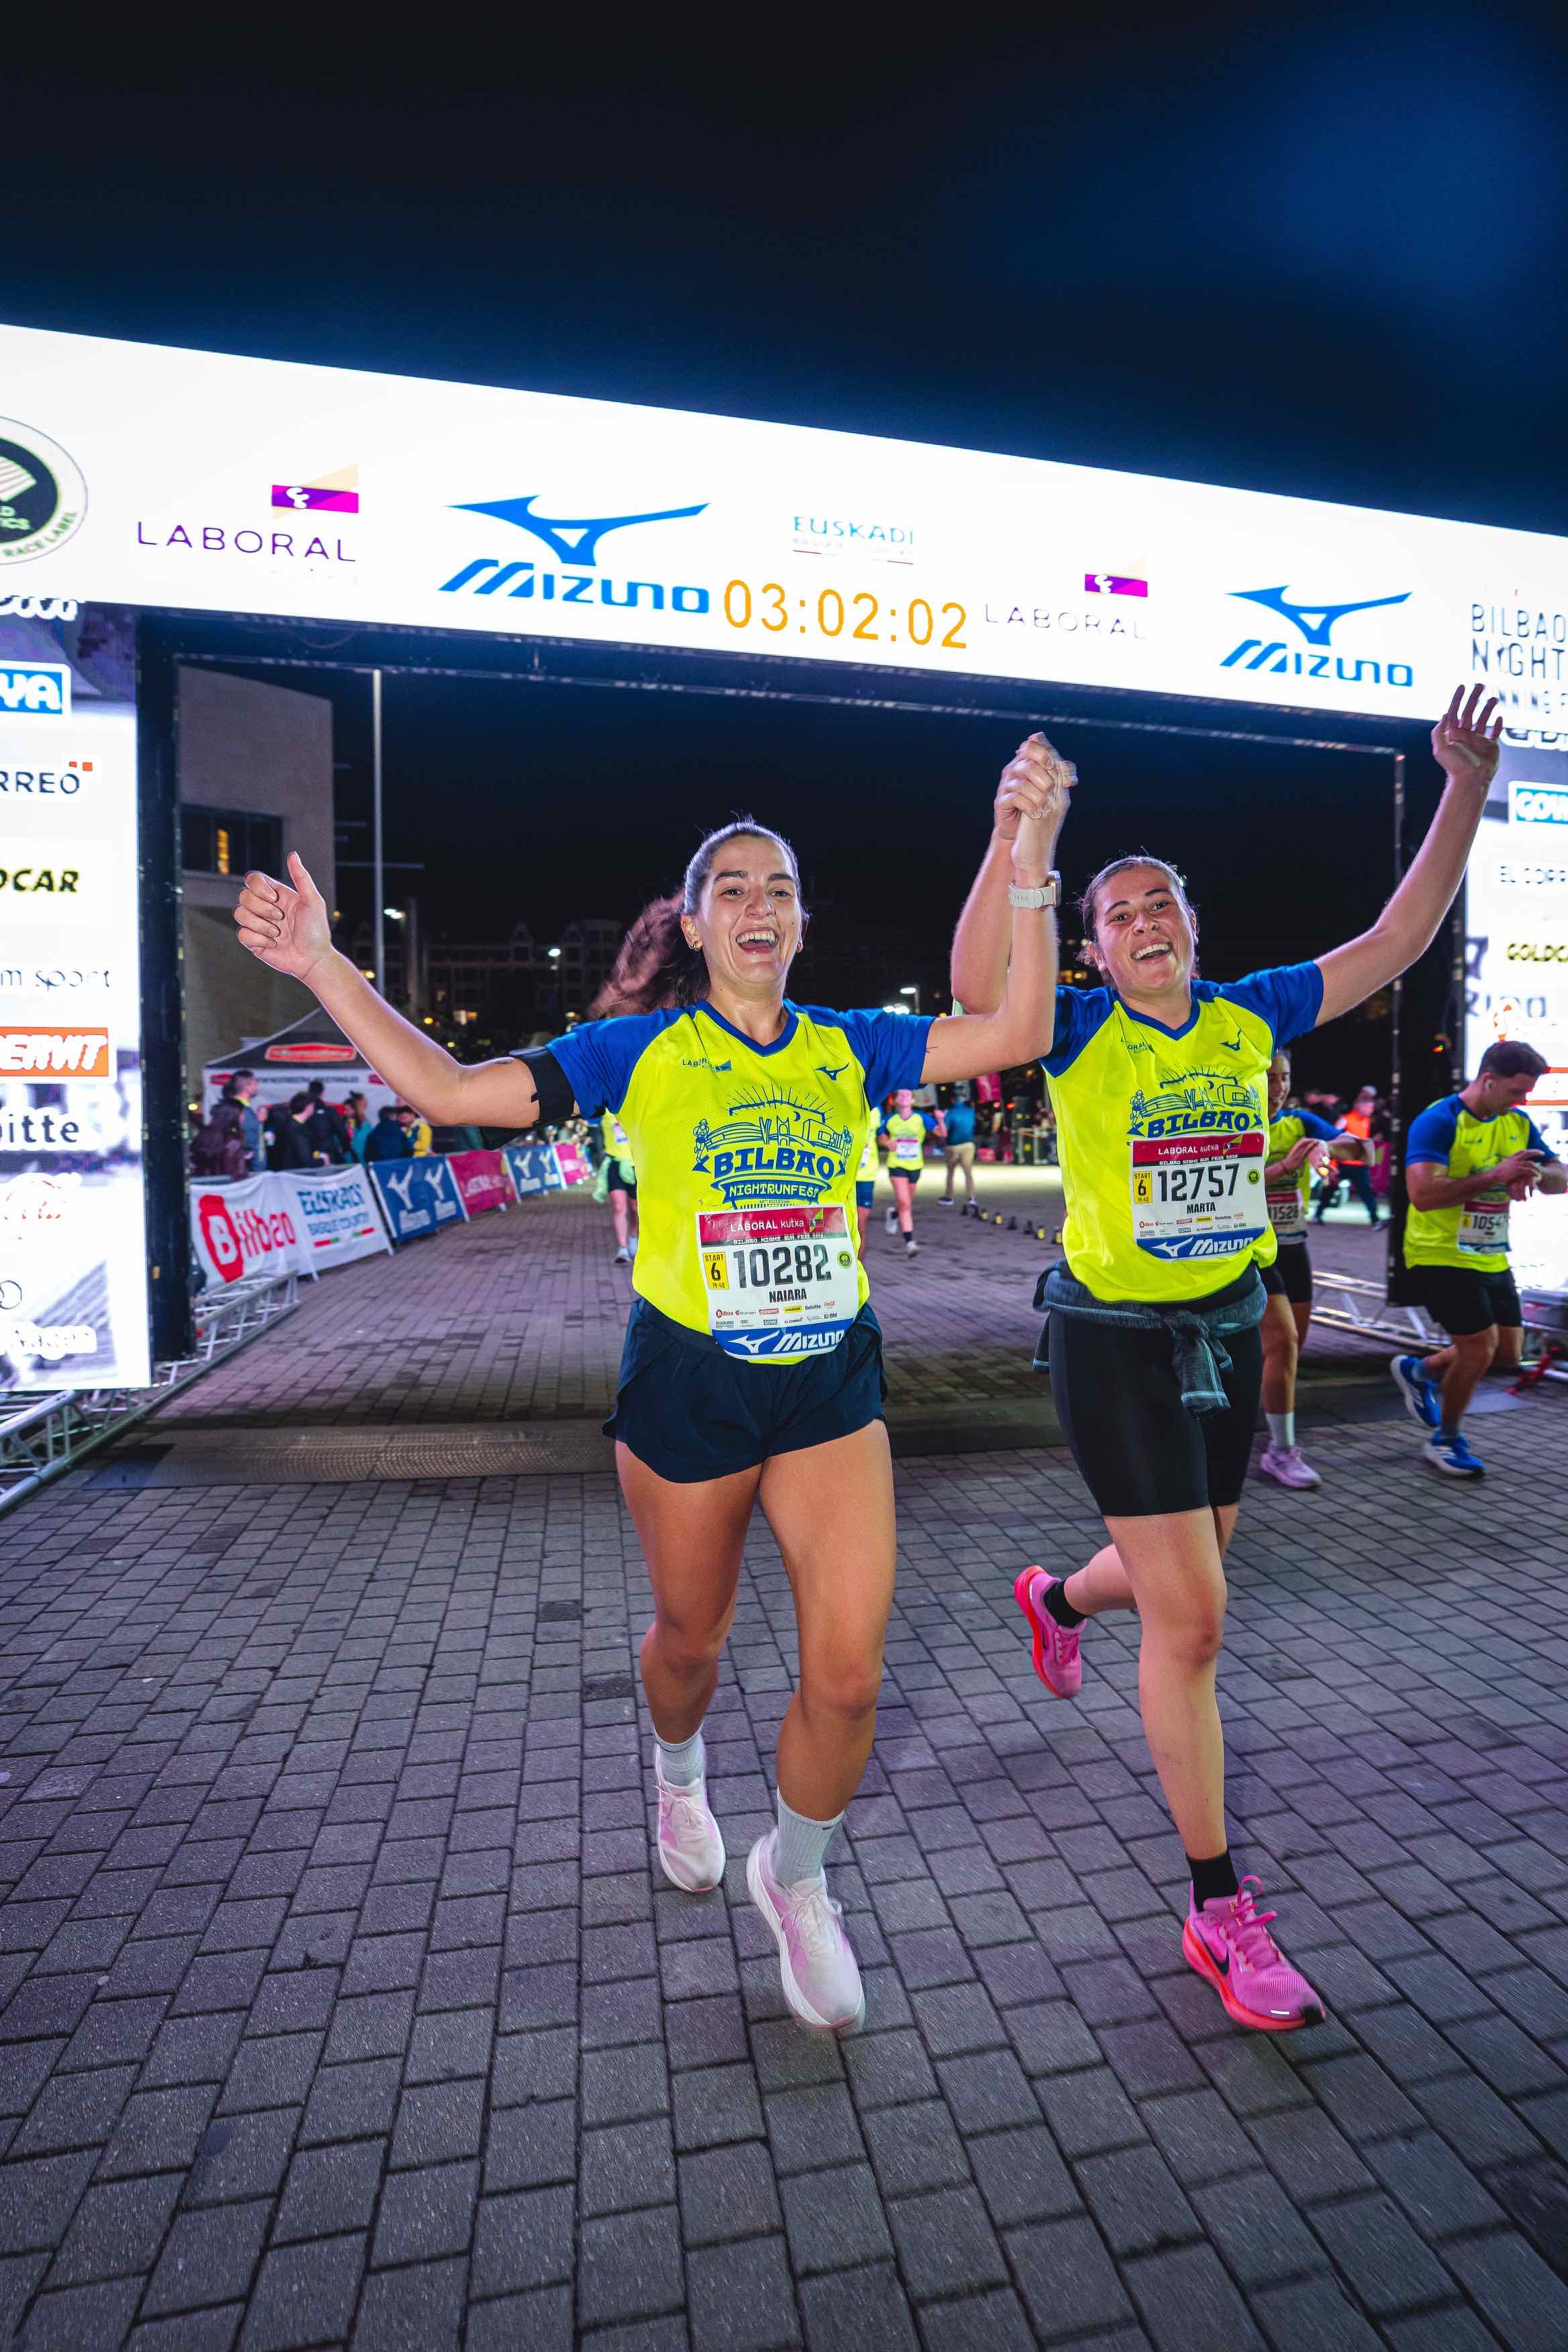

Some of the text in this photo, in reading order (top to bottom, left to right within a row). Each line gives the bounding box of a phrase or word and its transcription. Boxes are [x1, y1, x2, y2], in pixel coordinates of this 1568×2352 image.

[137, 522, 356, 562] LABORAL
[794, 516, 914, 545] EUSKADI
[724, 579, 967, 649] 03:02:02
[984, 603, 1148, 639] LABORAL
[1472, 604, 1567, 643] BILBAO
[0, 1114, 80, 1143] itte
[1148, 1110, 1250, 1138] BILBAO
[1158, 1144, 1220, 1155] LABORAL kutxa
[714, 1147, 835, 1181] BILBAO
[729, 1183, 818, 1198] NIGHTRUNFEST
[1138, 1179, 1146, 1195] 6
[1157, 1163, 1240, 1202] 12757
[1187, 1202, 1216, 1214] MARTA
[730, 1218, 804, 1232] LABORAL kutxa
[705, 1254, 724, 1262] START
[712, 1263, 721, 1281] 6
[733, 1244, 832, 1289] 10282
[769, 1288, 807, 1303] NAIARA
[716, 1310, 734, 1318] Bilbao
